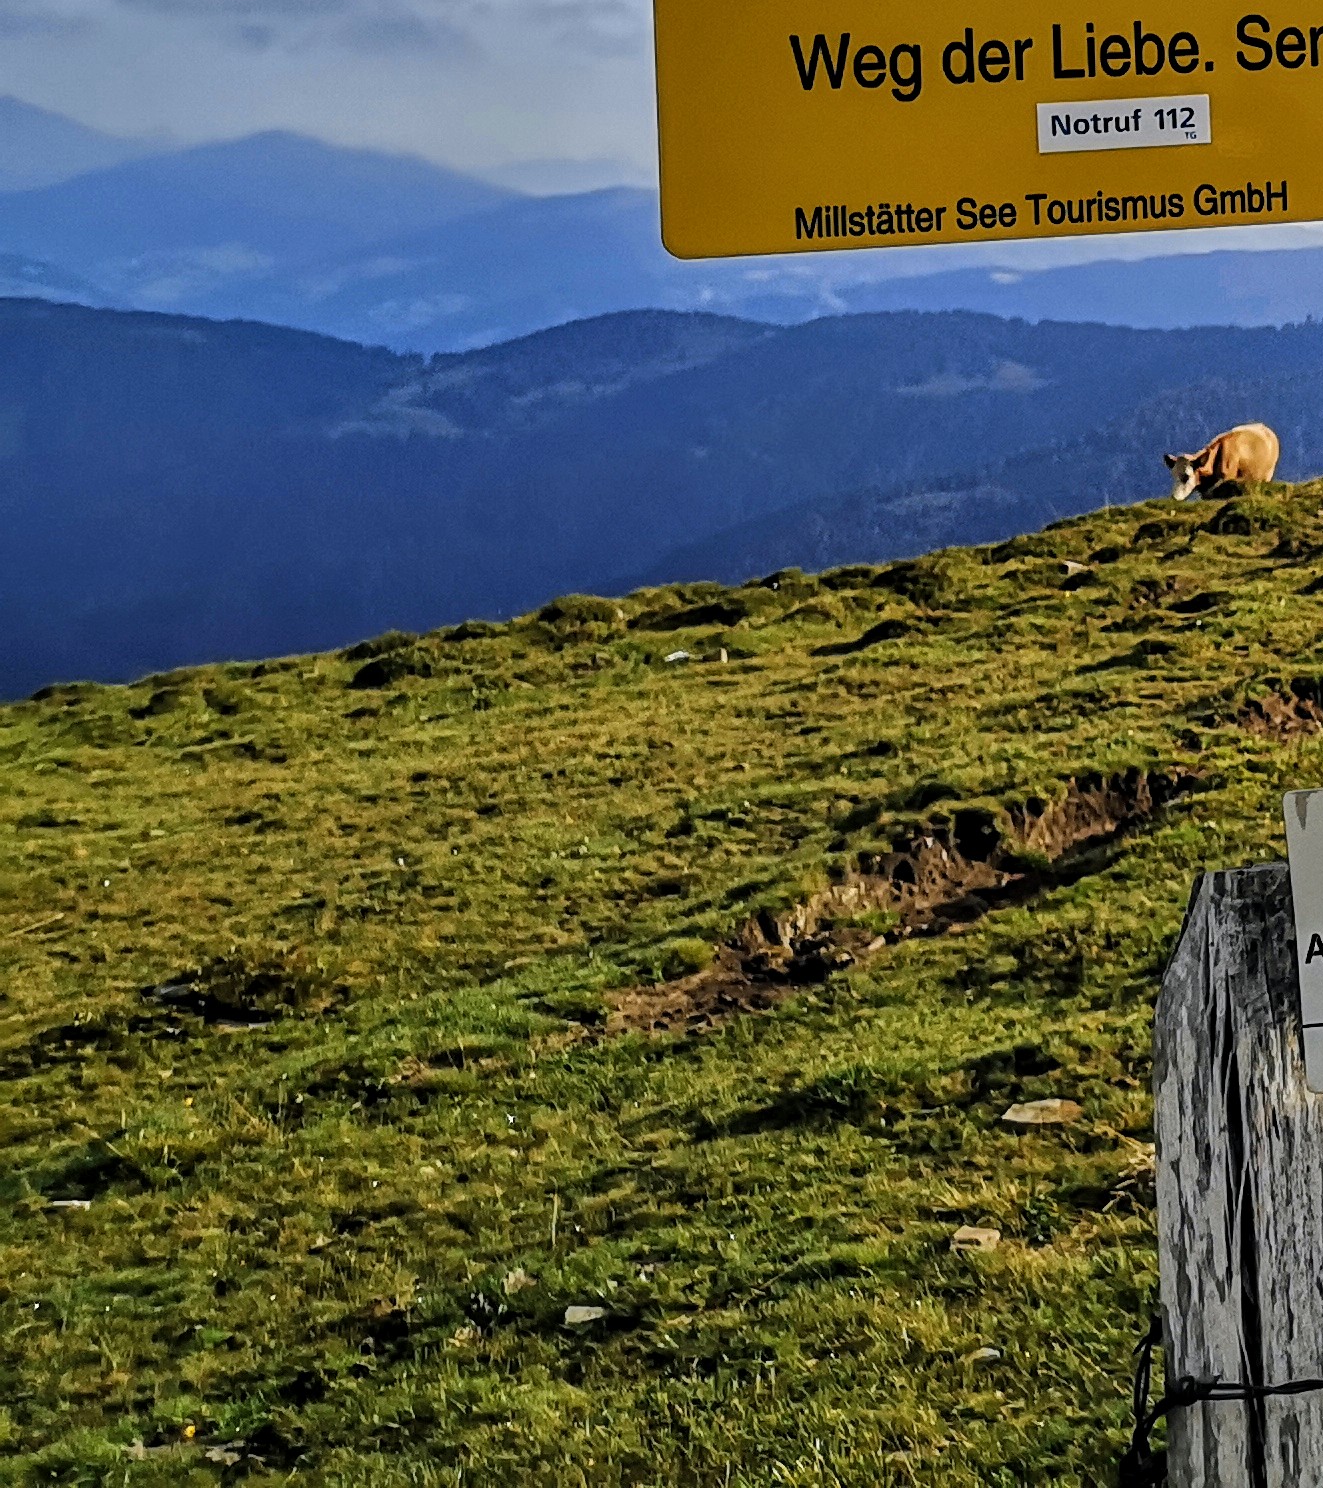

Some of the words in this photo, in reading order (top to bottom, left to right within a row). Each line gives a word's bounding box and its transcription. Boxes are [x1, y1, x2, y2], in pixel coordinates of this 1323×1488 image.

[789, 33, 921, 102] Weg
[943, 28, 1033, 84] der
[1052, 21, 1214, 79] Liebe.
[1052, 109, 1141, 136] Notruf
[1155, 107, 1195, 129] 112
[1185, 131, 1196, 139] TG
[795, 203, 946, 239] Millstätter
[957, 198, 1016, 230] See
[1025, 191, 1184, 225] Tourismus
[1194, 181, 1287, 215] GmbH
